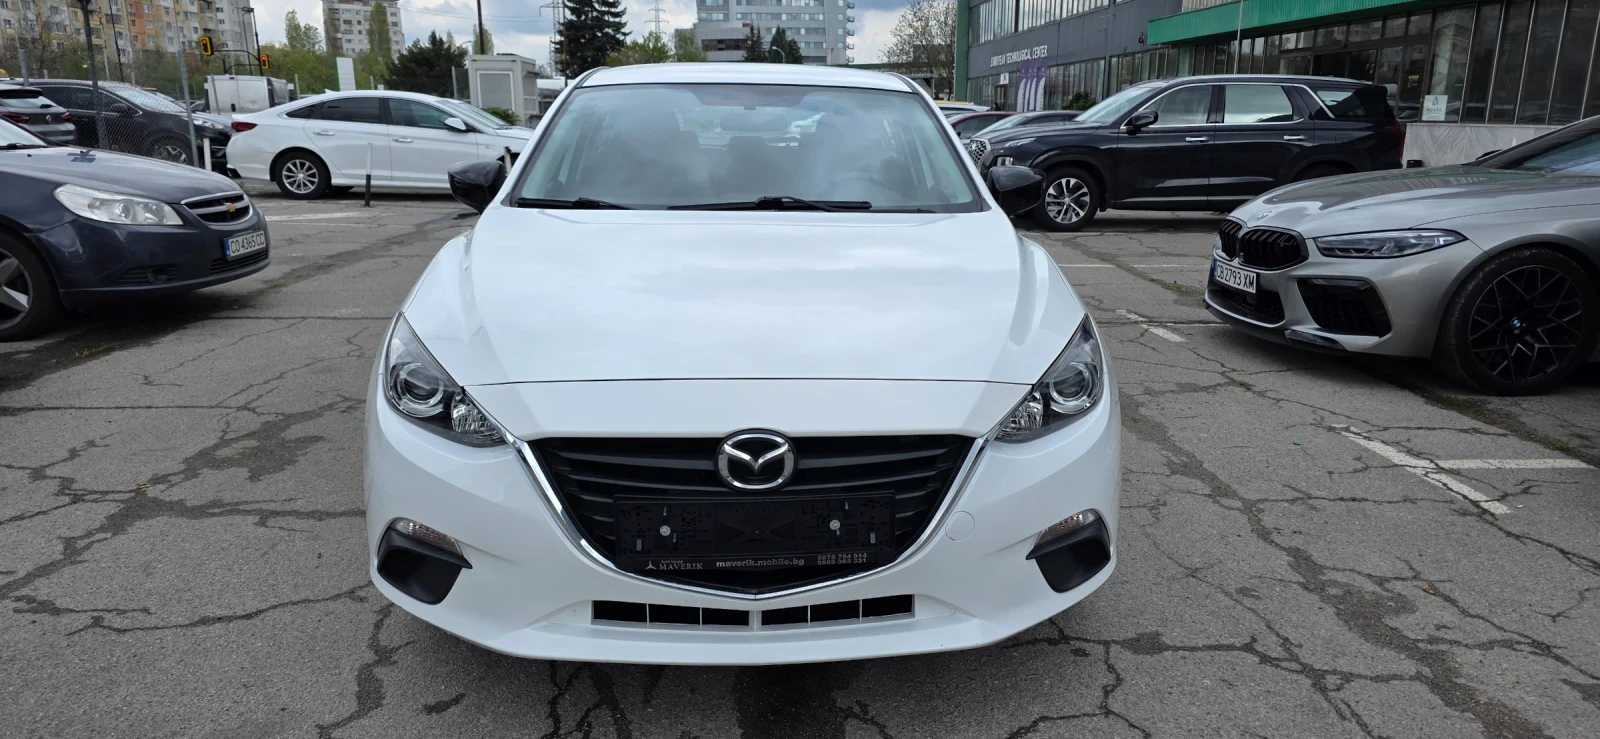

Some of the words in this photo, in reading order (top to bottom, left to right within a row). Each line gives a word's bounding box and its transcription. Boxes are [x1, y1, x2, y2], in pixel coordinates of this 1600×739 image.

[1033, 45, 1047, 59] CENTER
[241, 235, 255, 250] 4365
[1225, 267, 1241, 285] 2793
[1244, 274, 1254, 290] XM
[659, 562, 704, 570] MAVERIK
[716, 557, 805, 568] maverik.mobile.bg
